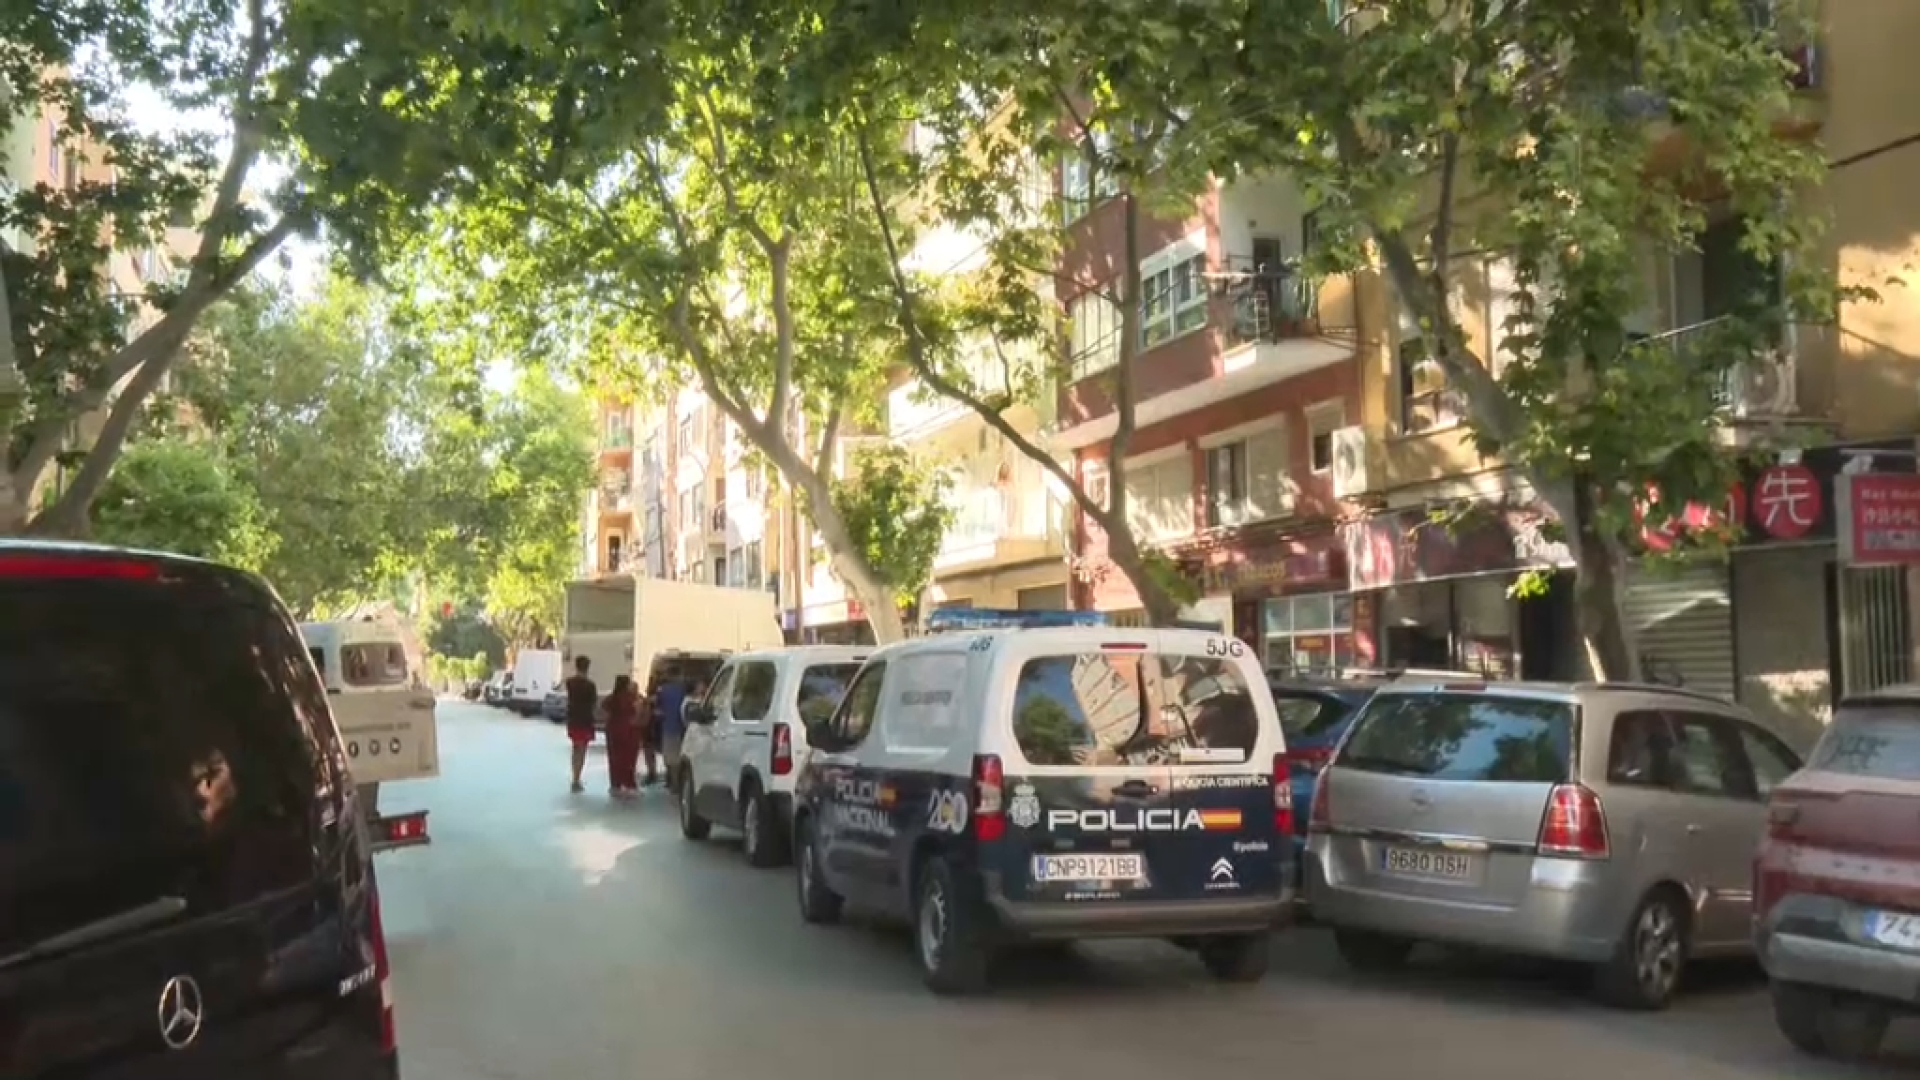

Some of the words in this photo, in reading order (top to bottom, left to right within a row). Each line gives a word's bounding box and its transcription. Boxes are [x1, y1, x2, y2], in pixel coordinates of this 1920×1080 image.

[1761, 470, 1812, 527] 先
[1206, 639, 1244, 657] 5JG
[1048, 809, 1205, 831] POLICIA
[1047, 858, 1137, 878] CNP9121BB
[1389, 850, 1430, 871] 9680
[1882, 914, 1920, 941] 74
